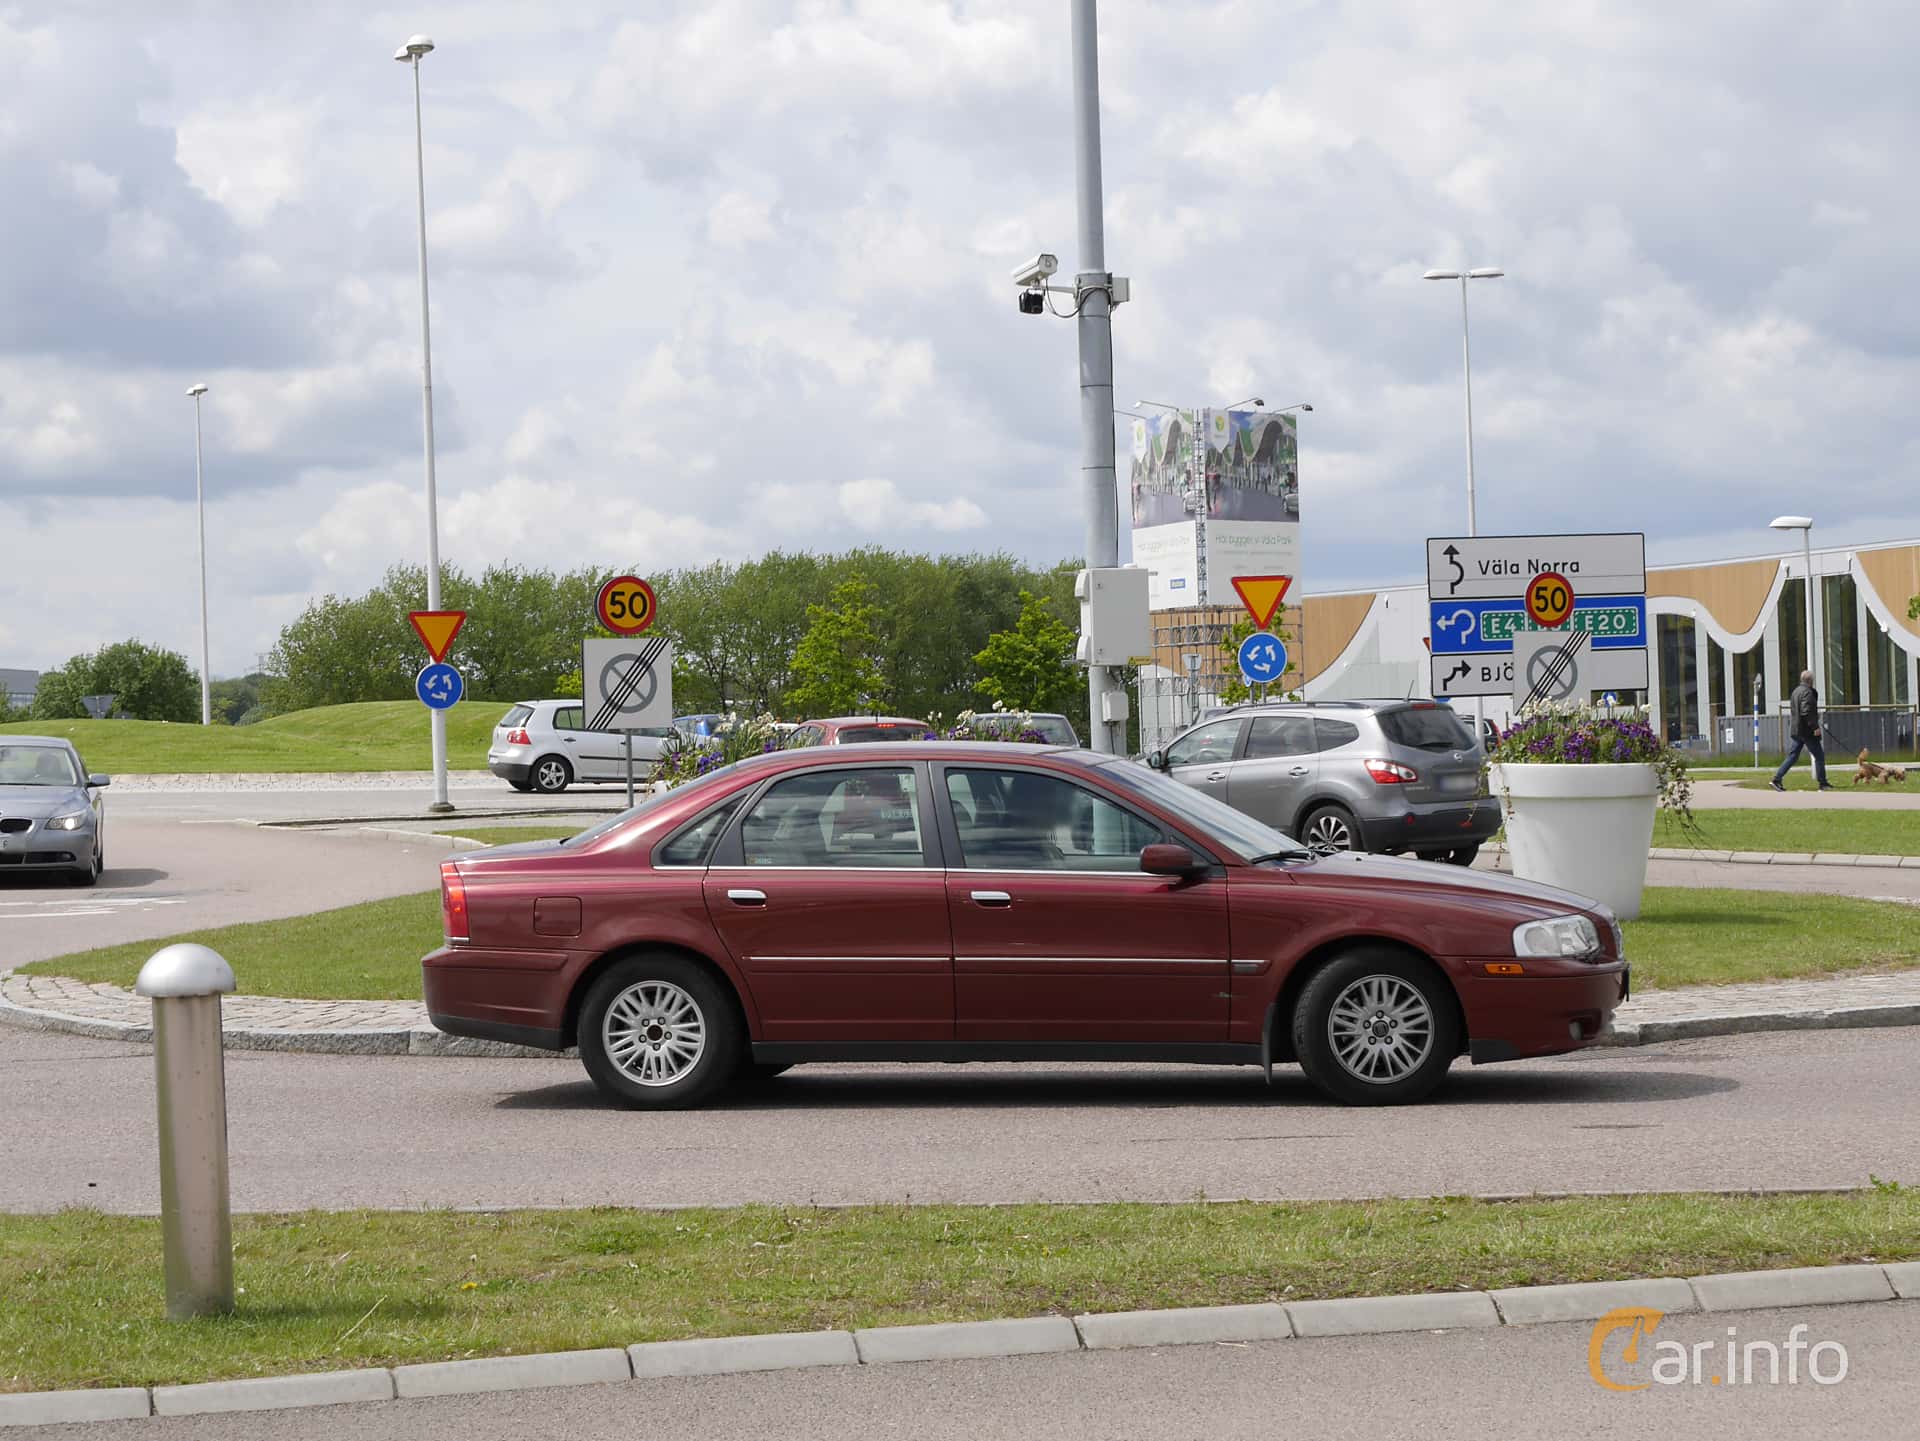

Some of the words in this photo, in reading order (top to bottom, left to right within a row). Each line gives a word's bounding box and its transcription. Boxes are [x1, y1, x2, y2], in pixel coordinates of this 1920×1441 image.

[1478, 559, 1520, 576] Väla
[1527, 558, 1580, 574] Norra
[609, 591, 648, 619] 50
[1534, 586, 1568, 613] 50
[1490, 617, 1517, 634] E4
[1584, 614, 1627, 632] E20
